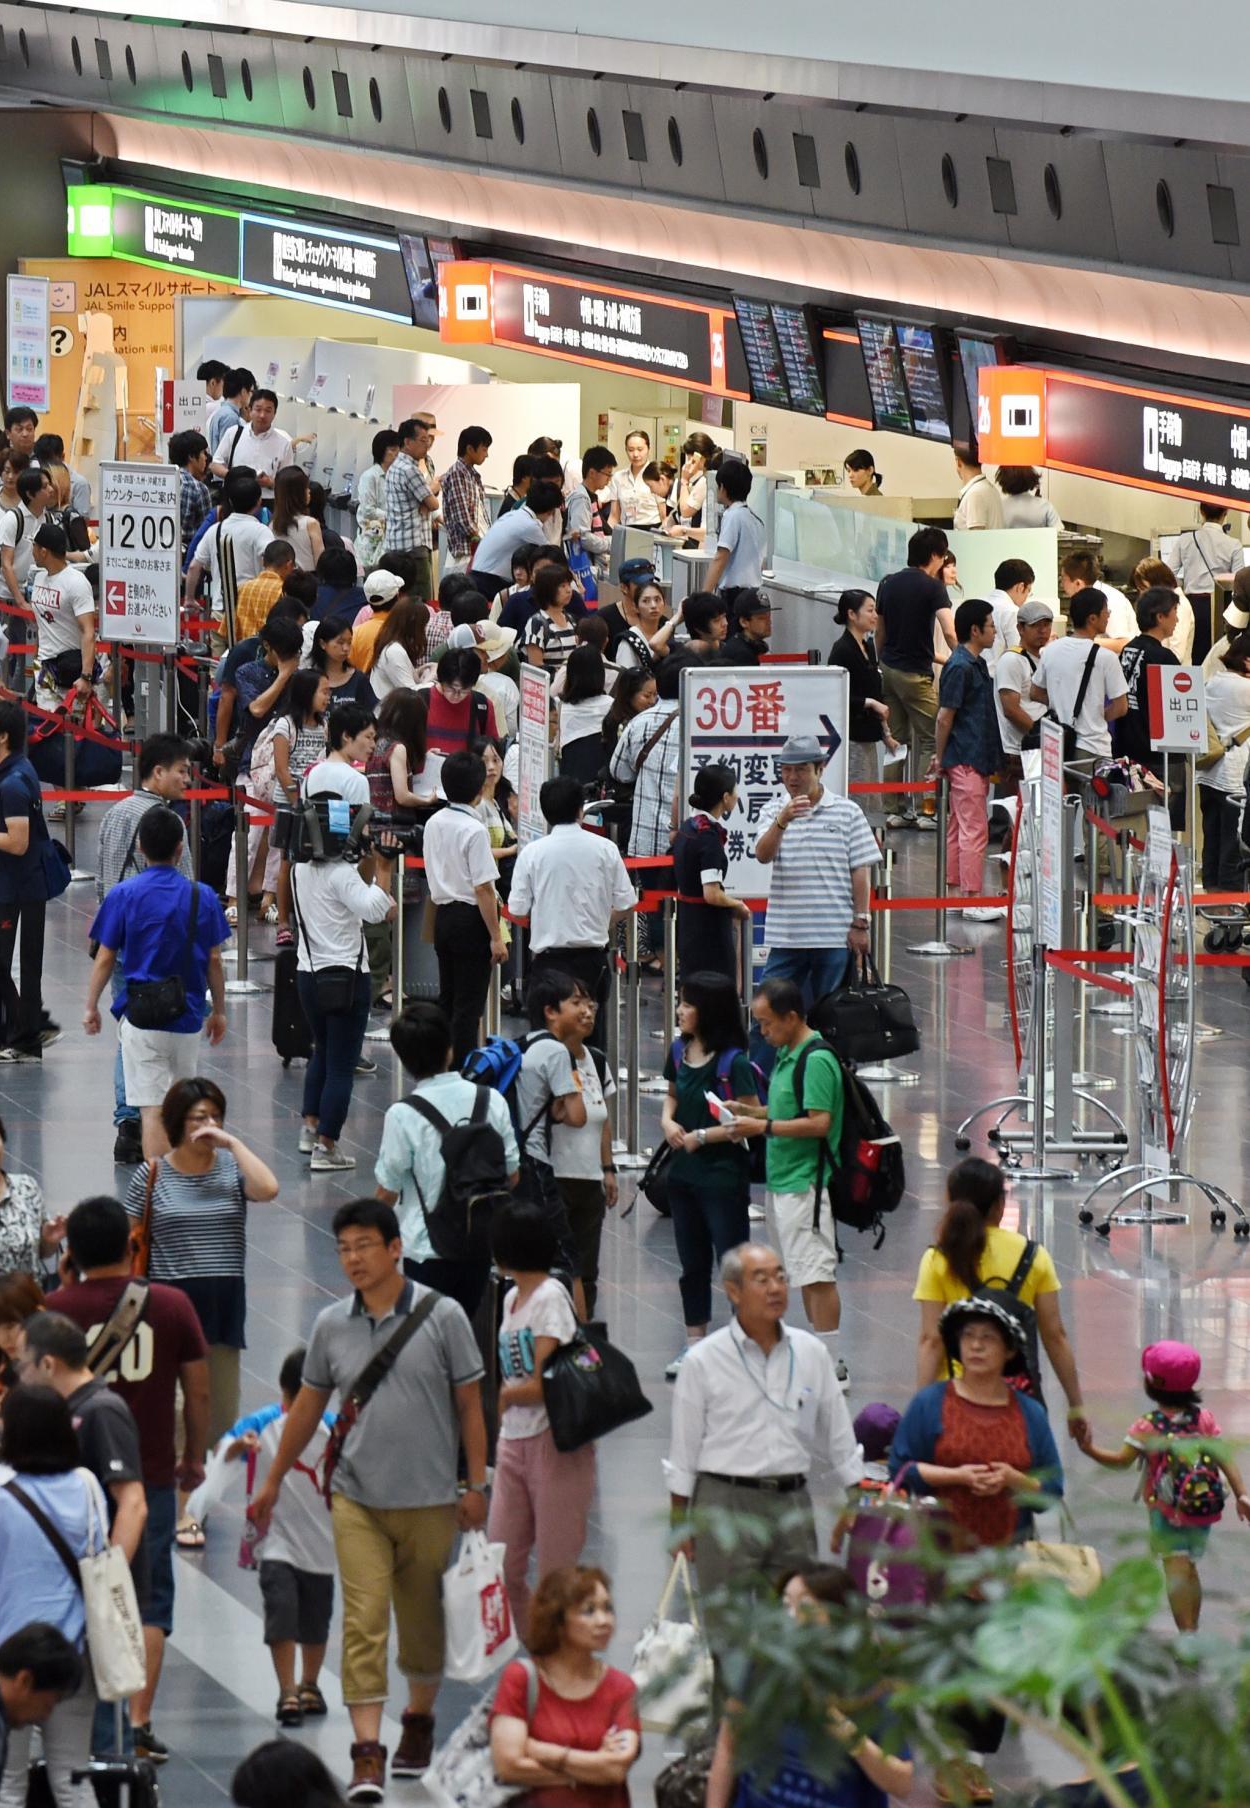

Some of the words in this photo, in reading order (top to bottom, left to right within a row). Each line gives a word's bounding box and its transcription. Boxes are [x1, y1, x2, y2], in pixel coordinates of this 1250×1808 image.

[85, 282, 216, 297] JALスマイルサポート
[85, 301, 104, 311] JAL
[107, 301, 135, 311] Smile
[138, 301, 174, 313] Suppo
[178, 396, 202, 406] 出口
[104, 488, 176, 505] カウンターのご案内
[105, 556, 172, 572] までにご出発のお客さま
[127, 583, 157, 600] 左側の列へ
[127, 602, 172, 618] お進みください
[695, 681, 786, 733] 30番
[1169, 697, 1198, 711] 出口
